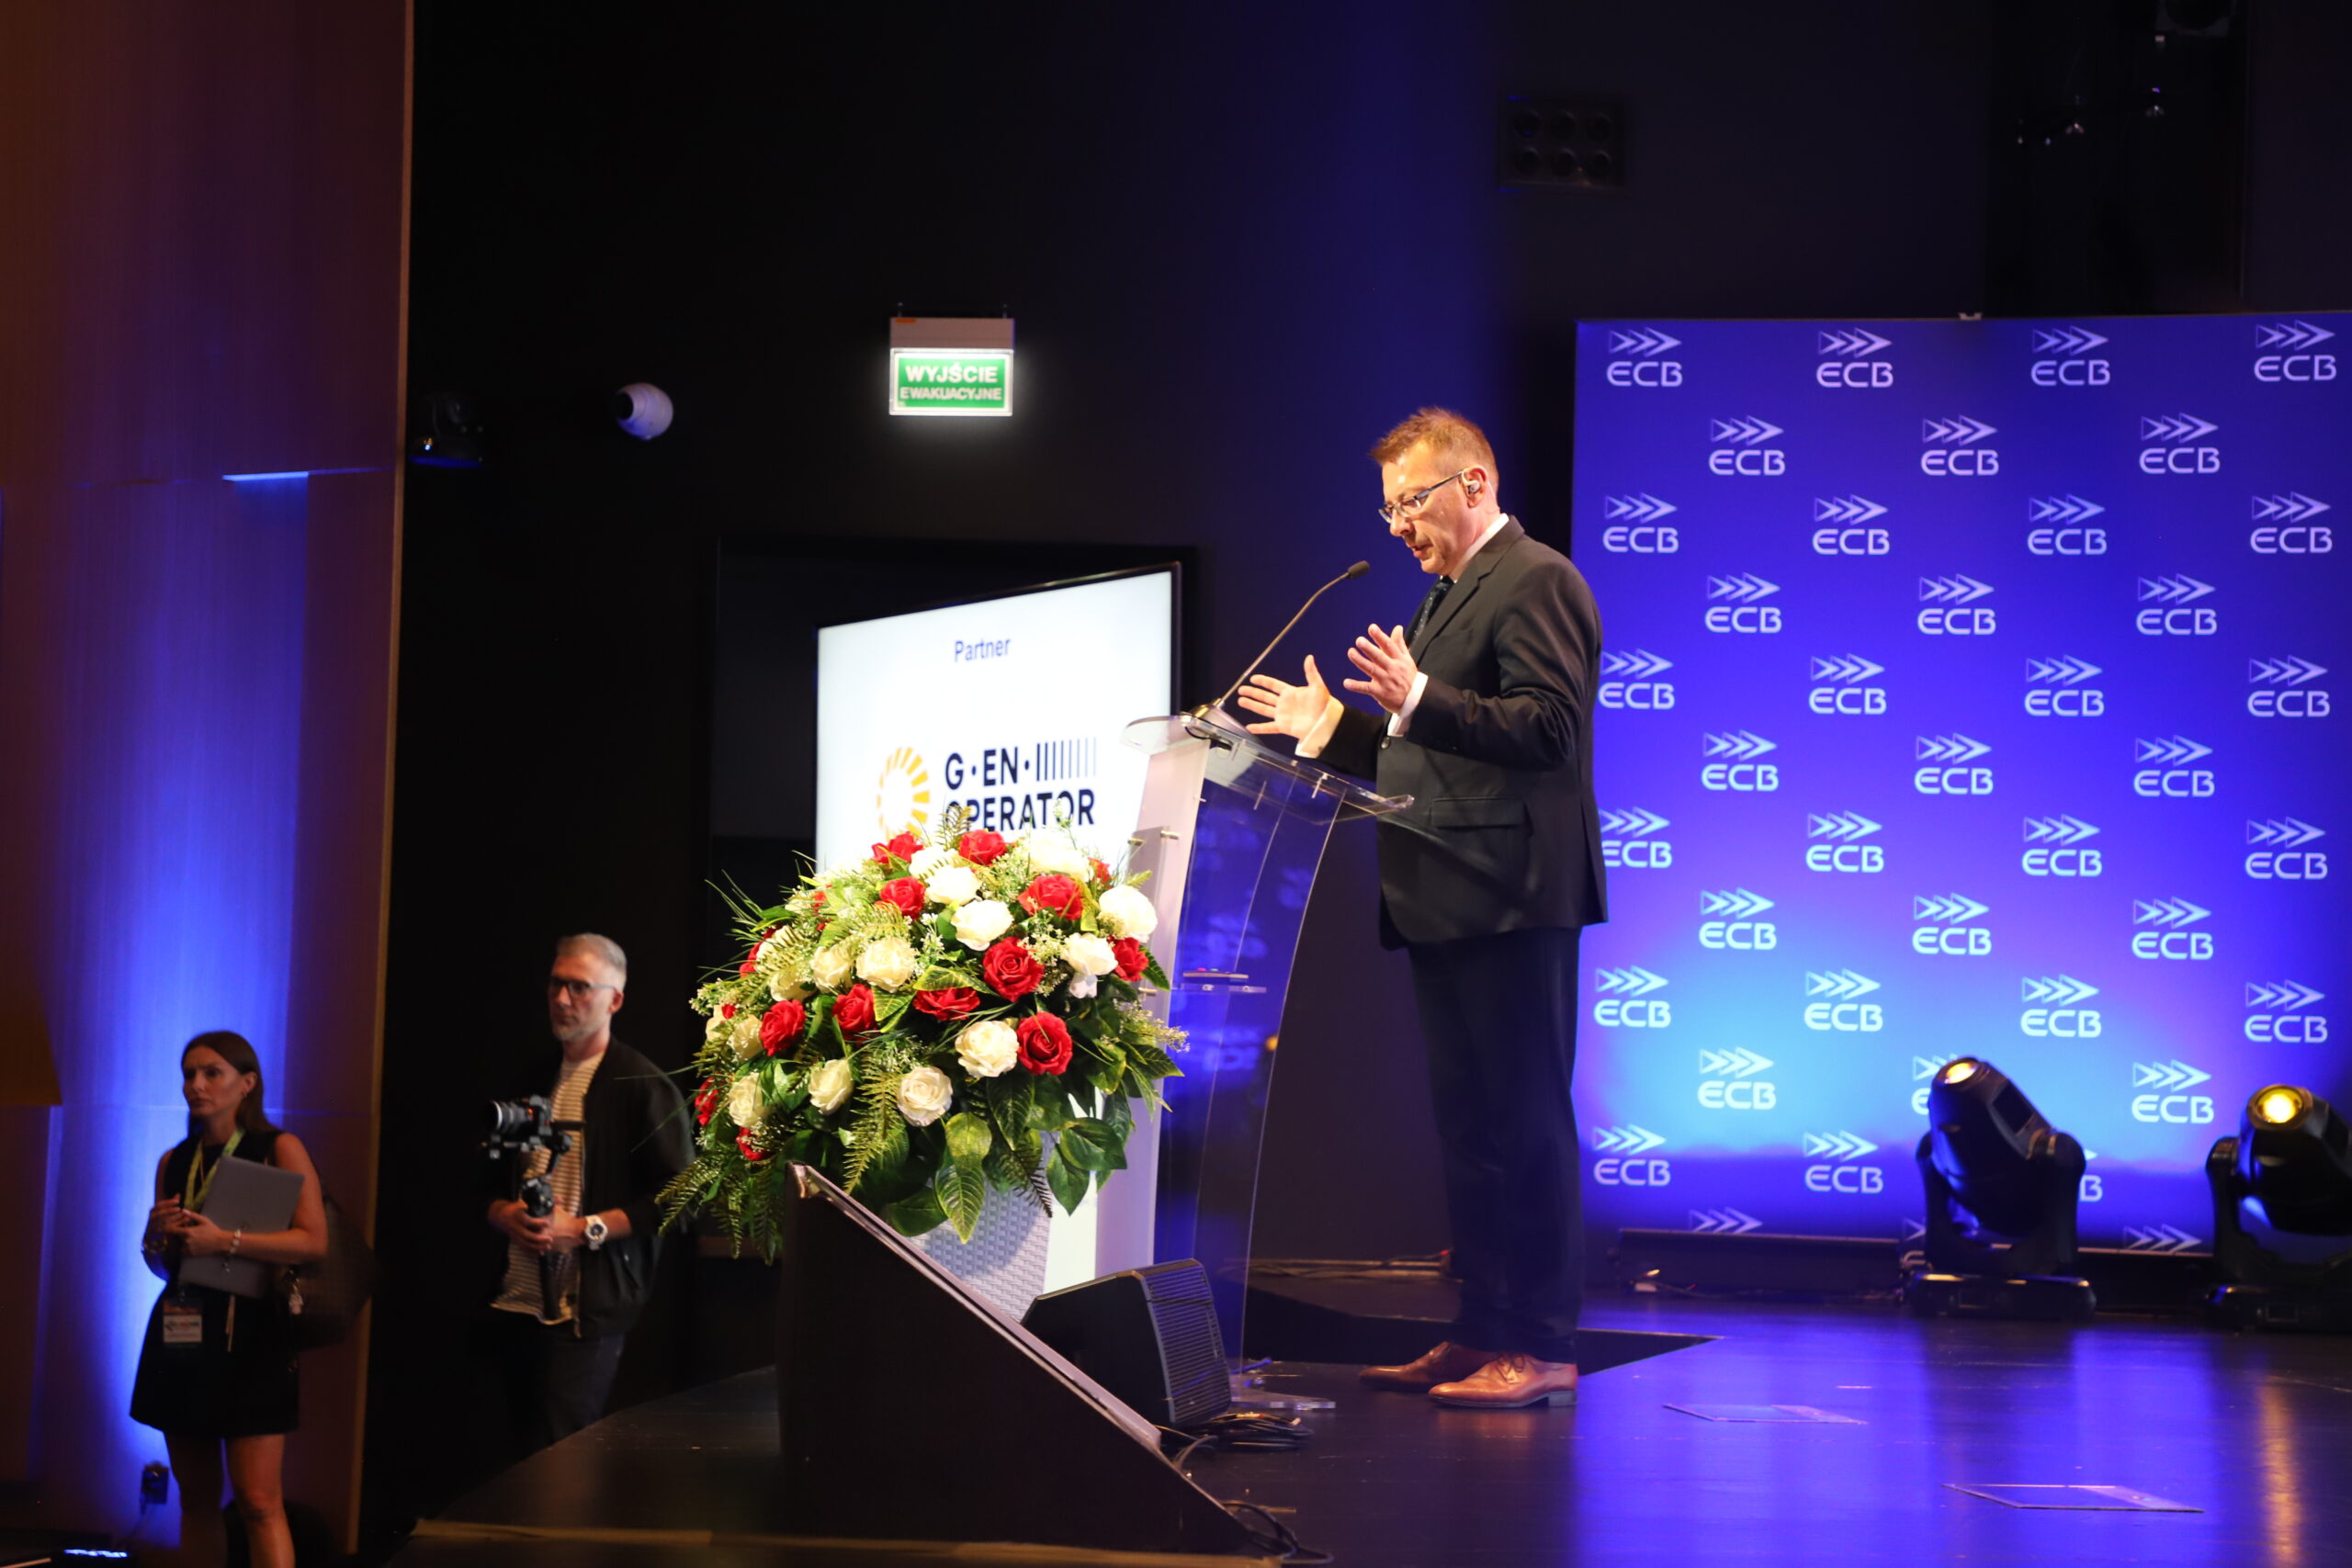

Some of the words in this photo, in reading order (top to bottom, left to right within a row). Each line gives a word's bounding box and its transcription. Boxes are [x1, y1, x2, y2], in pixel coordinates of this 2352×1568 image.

[905, 362, 998, 383] WYJŚCIE
[1607, 361, 1682, 387] ECB
[1816, 362, 1893, 388] ECB
[2031, 360, 2110, 386] ECB
[2254, 355, 2336, 381] ECB
[899, 387, 1002, 400] EWAKUACYJNE
[1709, 450, 1785, 475] ECB
[1921, 450, 1998, 476] ECB
[2140, 447, 2220, 474] ECB
[1603, 526, 1679, 553] ECB
[1813, 529, 1890, 555] ECB
[2028, 529, 2107, 555] ECB
[2250, 527, 2332, 553] ECB
[1705, 606, 1781, 633] ECB
[1917, 608, 1996, 635] ECB
[2136, 609, 2217, 635] ECB
[955, 638, 1011, 662] Partner
[1599, 682, 1675, 709] ECB
[1809, 688, 1886, 715] ECB
[2024, 690, 2104, 716] ECB
[2247, 691, 2330, 716] ECB
[1702, 764, 1779, 791] ECB
[1915, 768, 1993, 795] ECB
[2133, 770, 2214, 796] ECB
[1602, 840, 1672, 868] ECB
[1806, 845, 1883, 873] ECB
[2022, 849, 2102, 876] ECB
[2245, 852, 2327, 879] ECB
[1699, 921, 1778, 950] ECB
[1912, 927, 1992, 955] ECB
[2132, 931, 2213, 959] ECB
[1593, 998, 1672, 1027] ECB
[1804, 1002, 1883, 1031] ECB
[2020, 1009, 2102, 1038] ECB
[2245, 1014, 2328, 1043] ECB
[1697, 1081, 1777, 1110] ECB
[2132, 1094, 2214, 1123] ECB
[1593, 1159, 1671, 1186] ECB
[1804, 1165, 1883, 1193] ECB
